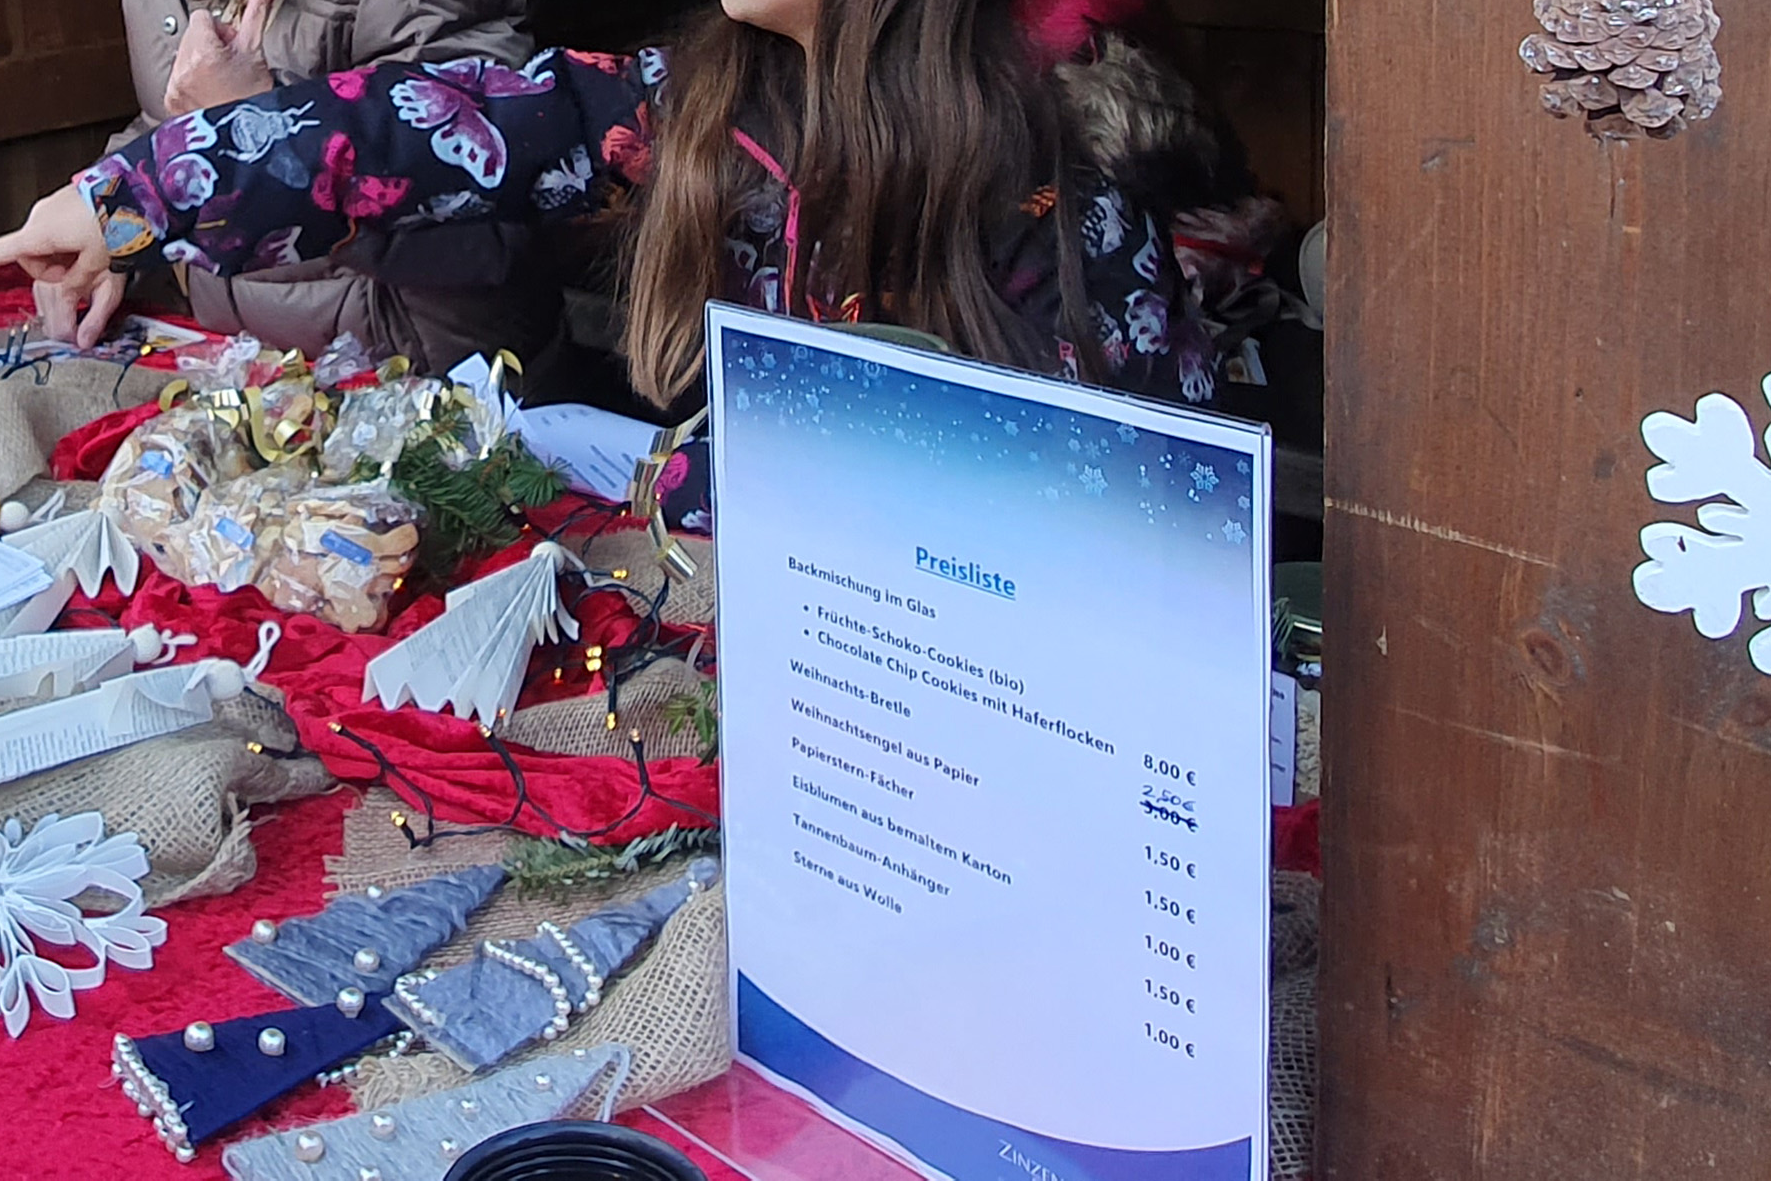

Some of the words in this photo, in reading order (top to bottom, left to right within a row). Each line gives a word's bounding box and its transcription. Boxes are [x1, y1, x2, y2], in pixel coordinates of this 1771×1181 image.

[788, 556, 881, 602] Backmischung
[885, 589, 902, 607] im
[907, 598, 936, 619] Glas
[915, 546, 1016, 598] Preisliste
[817, 606, 984, 678] Früchte-Schoko-Cookies
[989, 669, 1024, 695] (bio)
[790, 659, 911, 718] Weihnachts-Bretle
[818, 631, 882, 666] Chocolate
[886, 657, 918, 681] Chip
[922, 670, 978, 702] Cookies
[982, 695, 1008, 714] mit
[1012, 704, 1115, 755] Haferflocken
[791, 698, 902, 754] Weihnachtsengel
[906, 748, 930, 766] aus
[934, 757, 979, 787] Papier
[792, 736, 914, 800] Papierstern-Fächer
[1144, 754, 1180, 780] 8.00
[1186, 770, 1196, 787] €
[793, 775, 858, 815] Eisblumen
[861, 808, 883, 826] aus
[887, 817, 957, 860] bemaltem
[962, 851, 1012, 885] Karton
[793, 813, 950, 896] Tannenbaum-Anhänger
[794, 851, 834, 880] Sterne
[838, 875, 859, 893] aus
[863, 884, 902, 914] Wolle
[1145, 845, 1180, 871] 1.50
[1186, 863, 1196, 879] €
[1145, 890, 1180, 916] 1.50
[1186, 909, 1195, 924] €
[1145, 935, 1180, 961] 1.00
[1186, 954, 1195, 969] €
[1145, 979, 1179, 1005] 1.50
[1186, 999, 1195, 1014] €
[1144, 1023, 1179, 1049] 1.00
[1185, 1043, 1195, 1058] €
